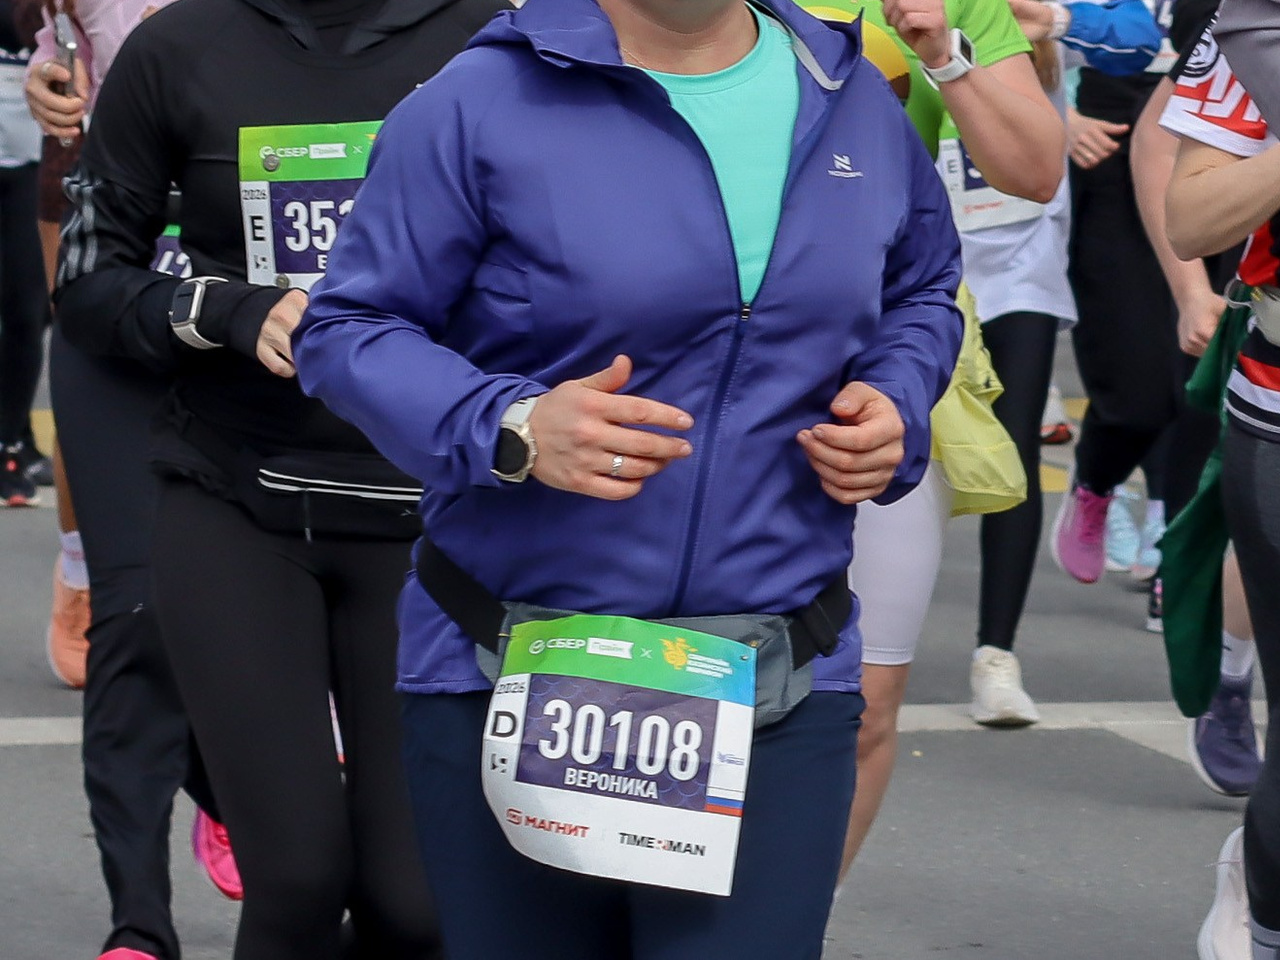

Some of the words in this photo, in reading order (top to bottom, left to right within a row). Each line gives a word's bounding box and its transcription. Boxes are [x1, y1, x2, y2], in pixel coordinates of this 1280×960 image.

[250, 214, 266, 242] E
[546, 637, 586, 650] СБЕР
[490, 710, 518, 738] D
[537, 698, 704, 782] 30108
[563, 767, 659, 800] ВЕРОНИКА
[524, 815, 590, 838] МАГНИТ
